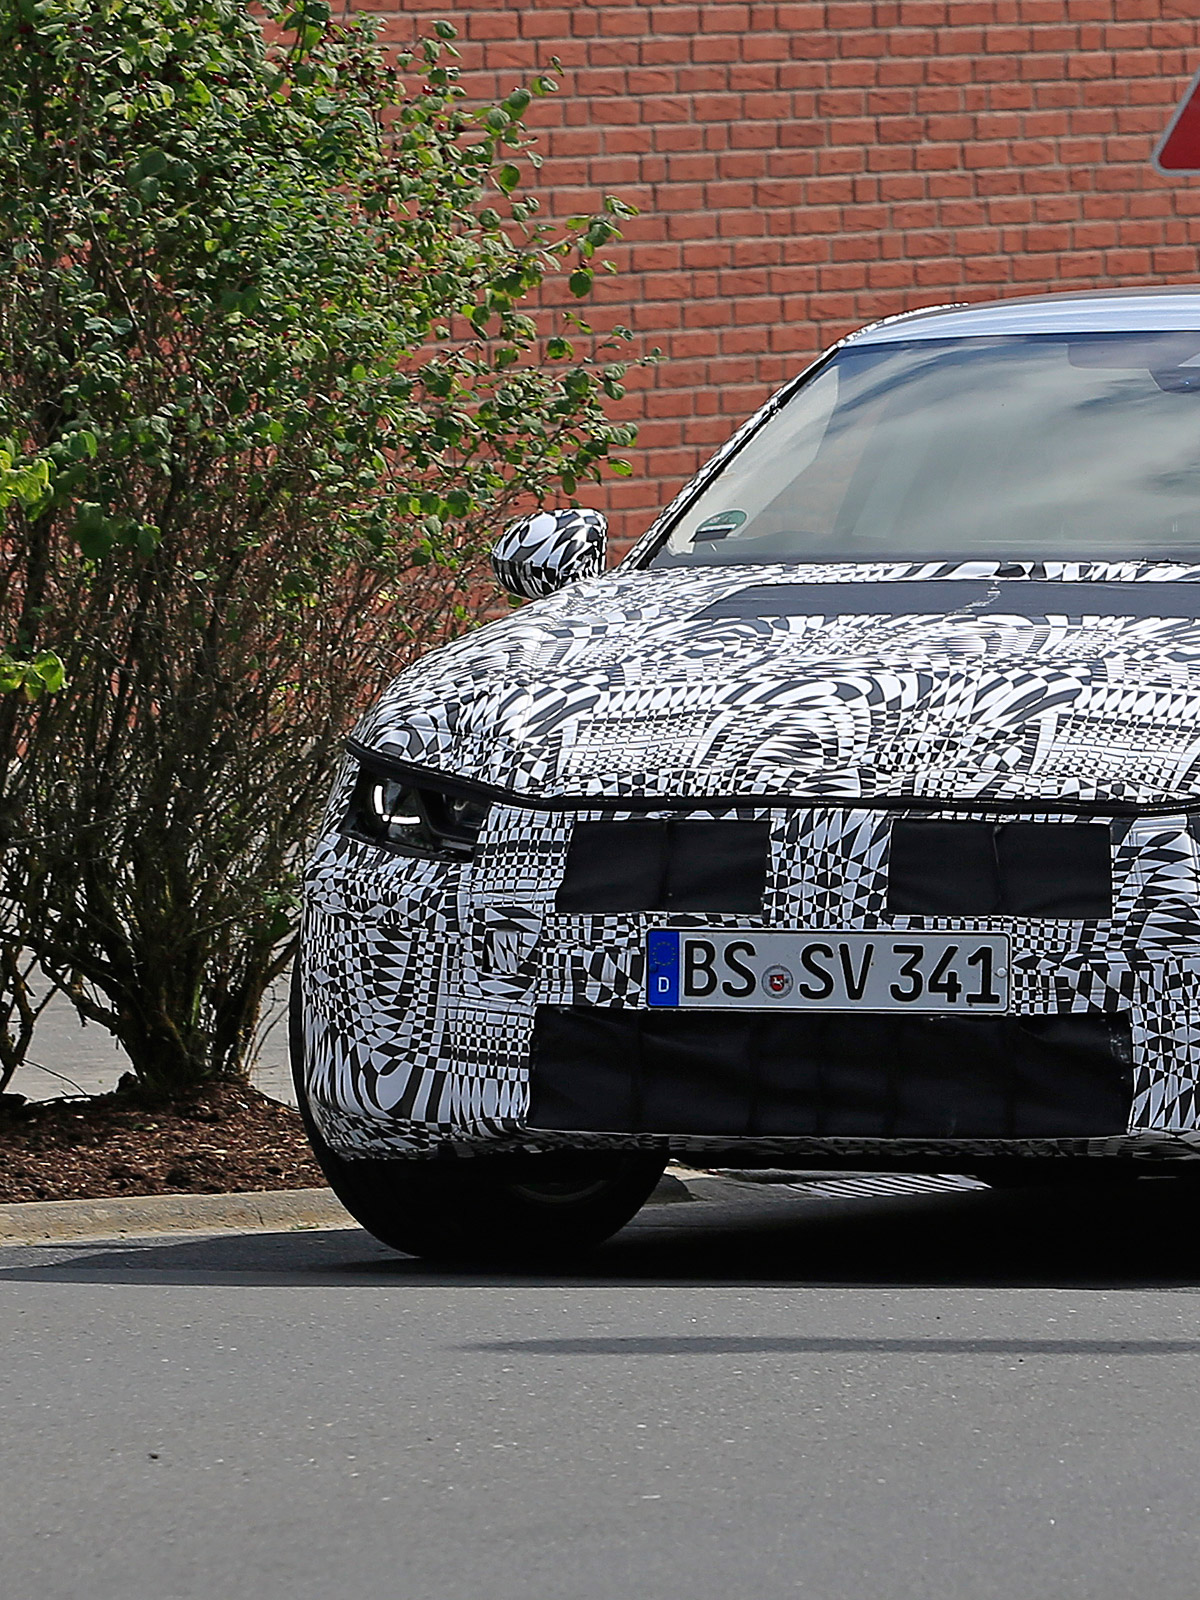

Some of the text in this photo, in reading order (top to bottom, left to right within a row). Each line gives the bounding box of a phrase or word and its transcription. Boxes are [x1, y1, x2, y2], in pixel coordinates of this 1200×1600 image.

[657, 976, 670, 993] D
[683, 940, 1000, 1004] BS SV 341
